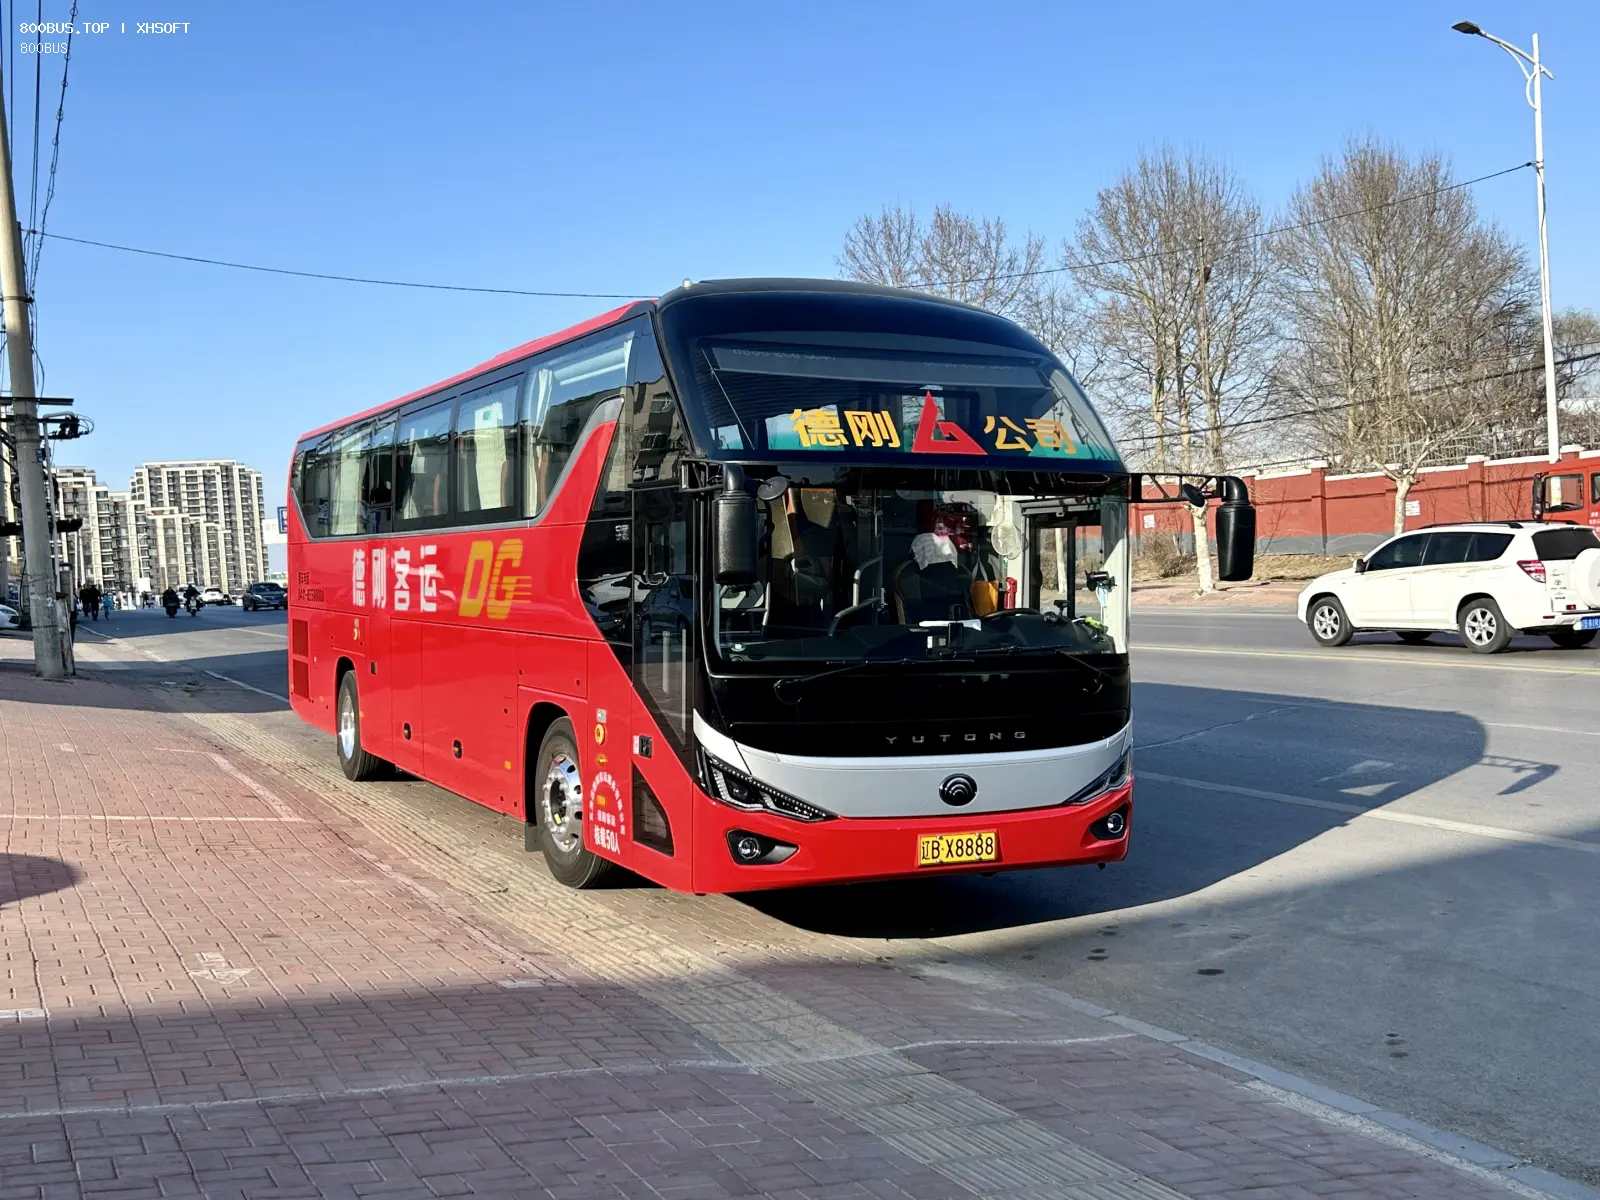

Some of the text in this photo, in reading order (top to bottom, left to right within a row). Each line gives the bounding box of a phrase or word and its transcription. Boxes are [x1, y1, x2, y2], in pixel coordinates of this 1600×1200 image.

[789, 408, 1077, 455] 德刚 公司
[352, 544, 438, 613] 德刚客运
[458, 538, 532, 621] DG
[885, 731, 1026, 745] YUTONG
